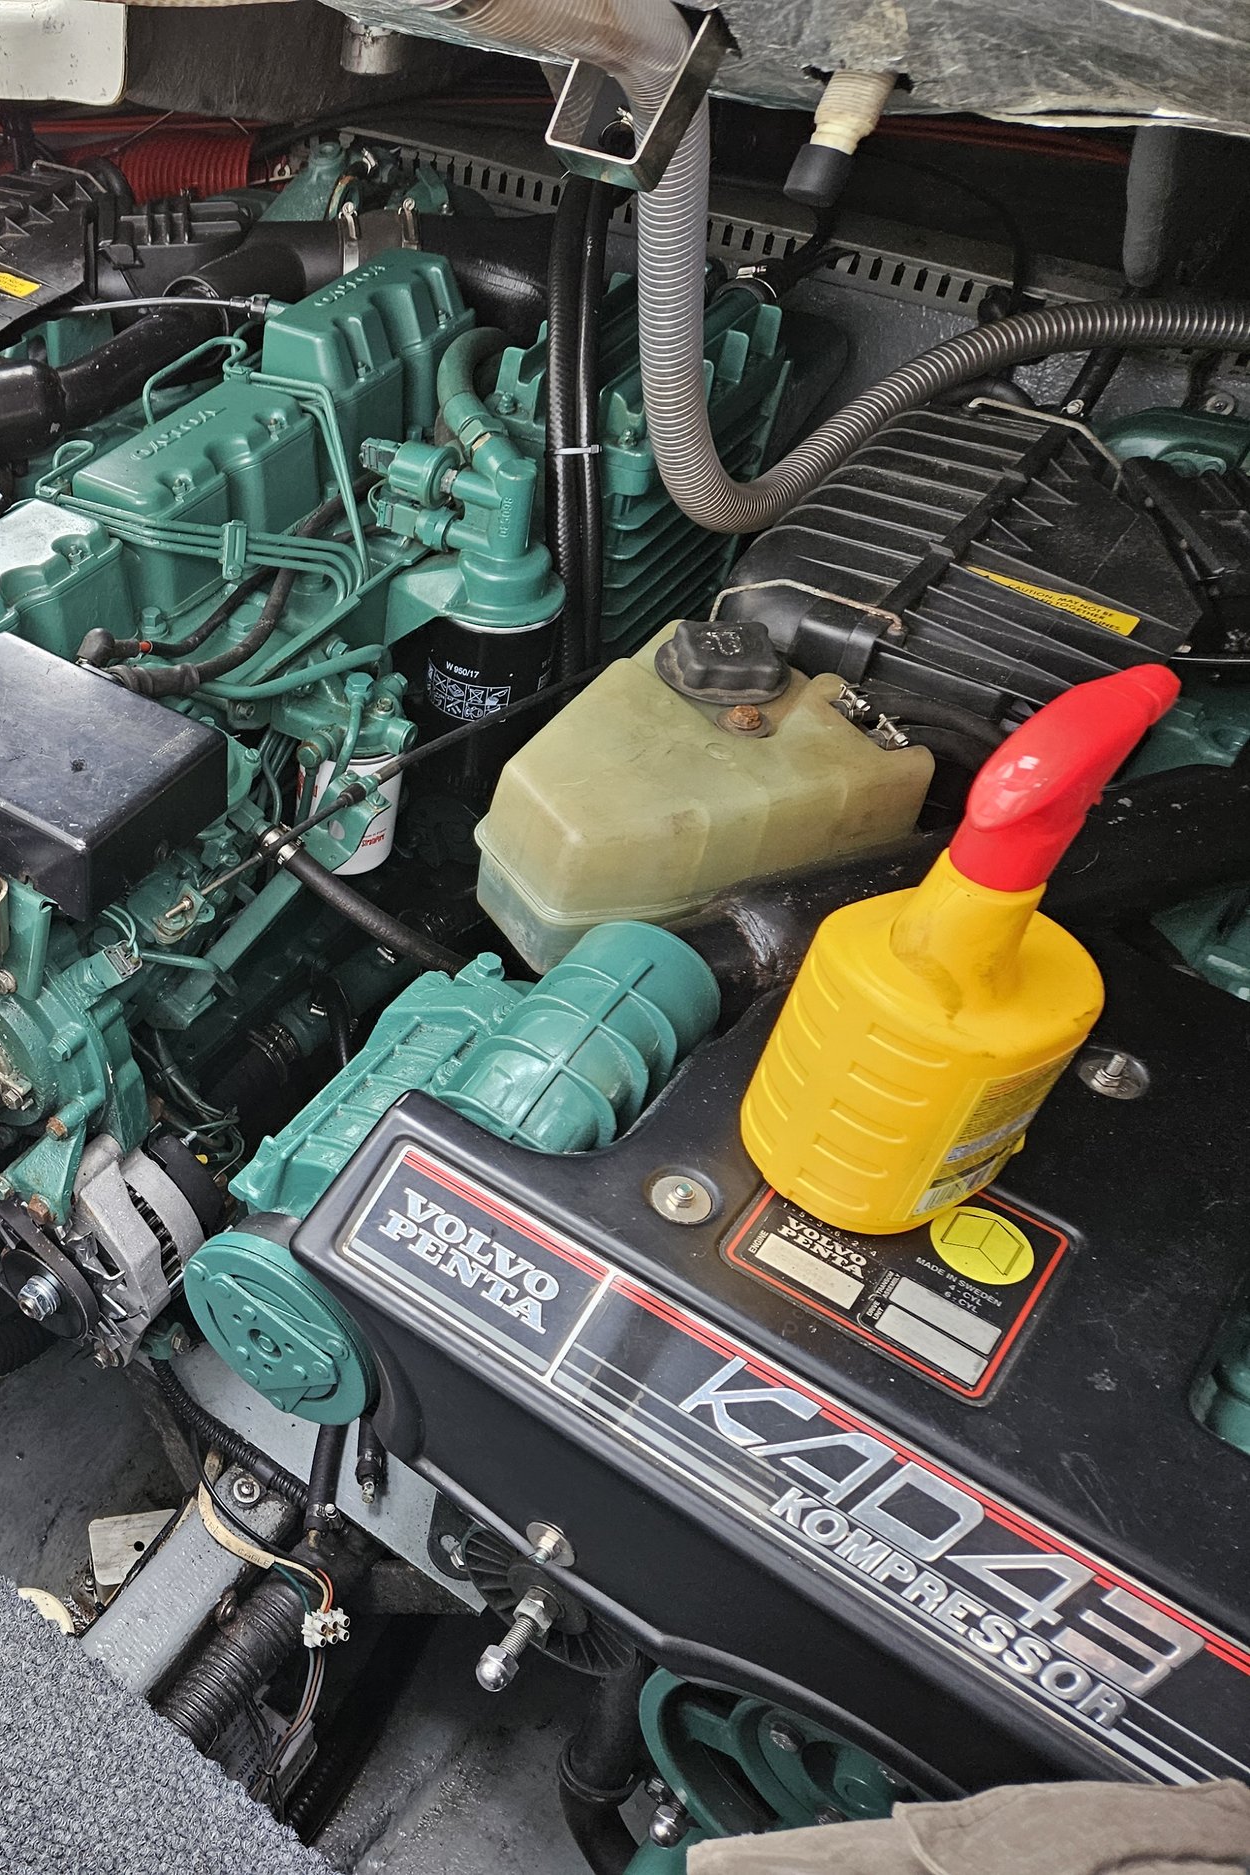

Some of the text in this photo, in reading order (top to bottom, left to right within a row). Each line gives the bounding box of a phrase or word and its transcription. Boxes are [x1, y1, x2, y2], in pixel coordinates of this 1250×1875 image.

[445, 661, 480, 679] W 950/17
[404, 1187, 560, 1301] VOLVO
[747, 1227, 769, 1256] ENGINE
[776, 1224, 863, 1279] PENTA
[787, 1215, 867, 1266] VOLVO
[379, 1209, 547, 1334] PENTA
[875, 1269, 895, 1296] TRANSOM
[881, 1271, 901, 1299] ASSEMBLY
[916, 1256, 1003, 1308] MADE IN SWEDEN
[865, 1298, 881, 1318] DRIVE
[871, 1305, 884, 1321] UNIT
[768, 1487, 1130, 1728] KOMPRESSOR
